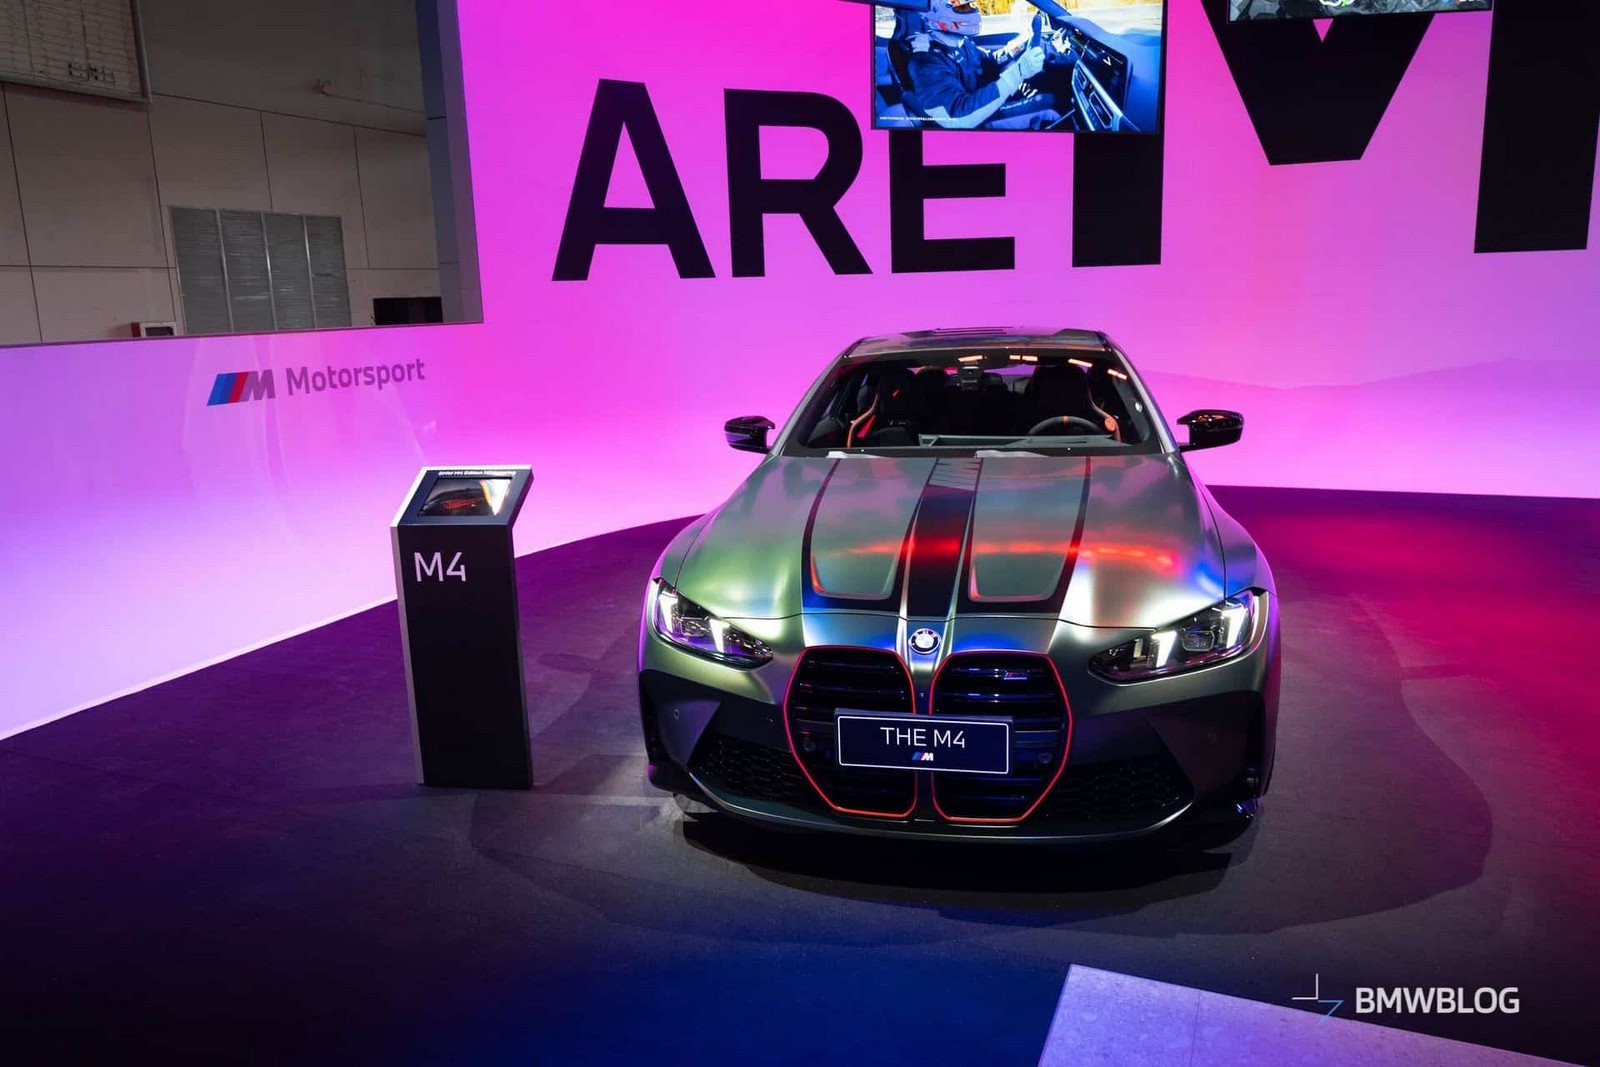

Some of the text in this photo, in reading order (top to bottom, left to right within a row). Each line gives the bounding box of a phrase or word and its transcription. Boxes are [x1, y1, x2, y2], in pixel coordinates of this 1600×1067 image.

[552, 78, 1016, 281] ARE
[285, 358, 426, 396] Motorsport
[413, 551, 467, 582] M4
[879, 726, 965, 749] THE M4
